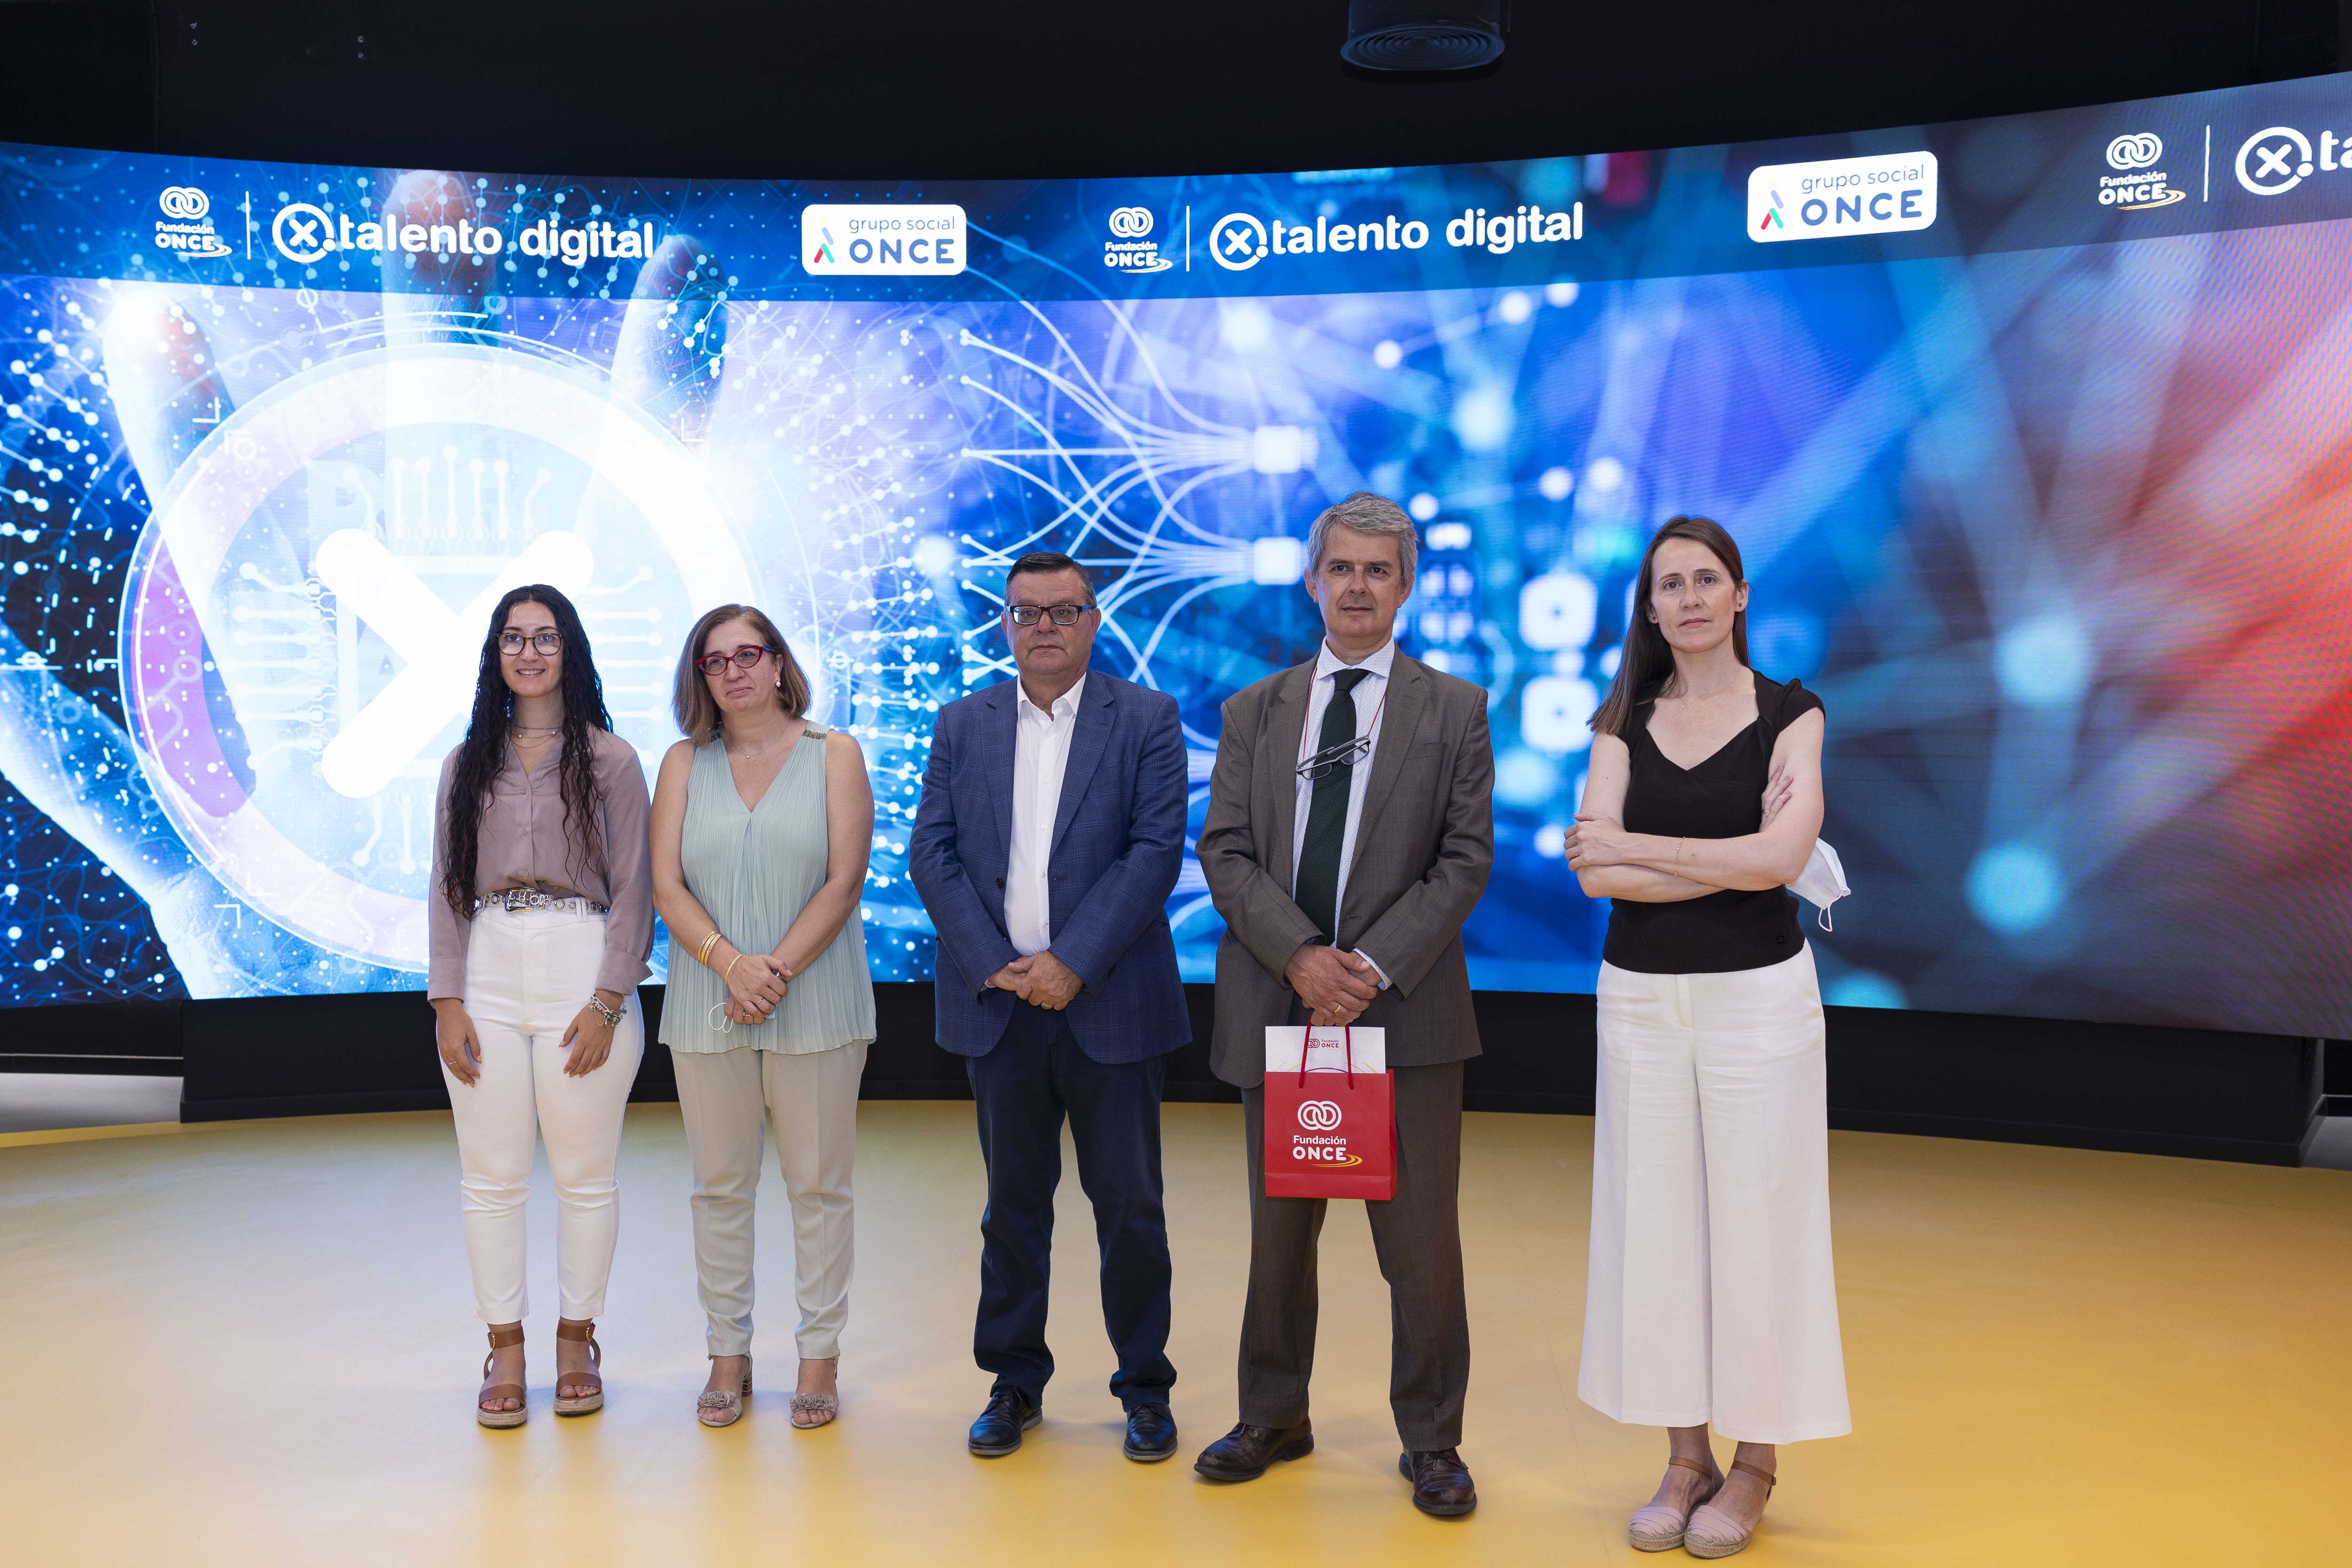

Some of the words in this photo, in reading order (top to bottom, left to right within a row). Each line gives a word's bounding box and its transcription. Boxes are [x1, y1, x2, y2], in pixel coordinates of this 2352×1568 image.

[1802, 173, 1861, 194] grupo
[1868, 165, 1924, 184] social
[2099, 171, 2167, 187] Fundación
[2098, 182, 2167, 205] ONCE
[1801, 189, 1922, 226] ONCE
[155, 221, 215, 234] Fundación
[849, 220, 900, 233] grupo
[907, 216, 954, 230] social
[1272, 215, 1429, 254] talento
[1446, 202, 1583, 254] digital
[155, 233, 215, 251] ONCE
[339, 213, 502, 254] talento
[520, 219, 653, 266] digital
[1105, 241, 1158, 251] Fundación
[849, 238, 954, 264] ONCE
[1104, 252, 1158, 267] ONCE
[1293, 1135, 1346, 1145] Fundación
[1293, 1146, 1347, 1161] ONCE
